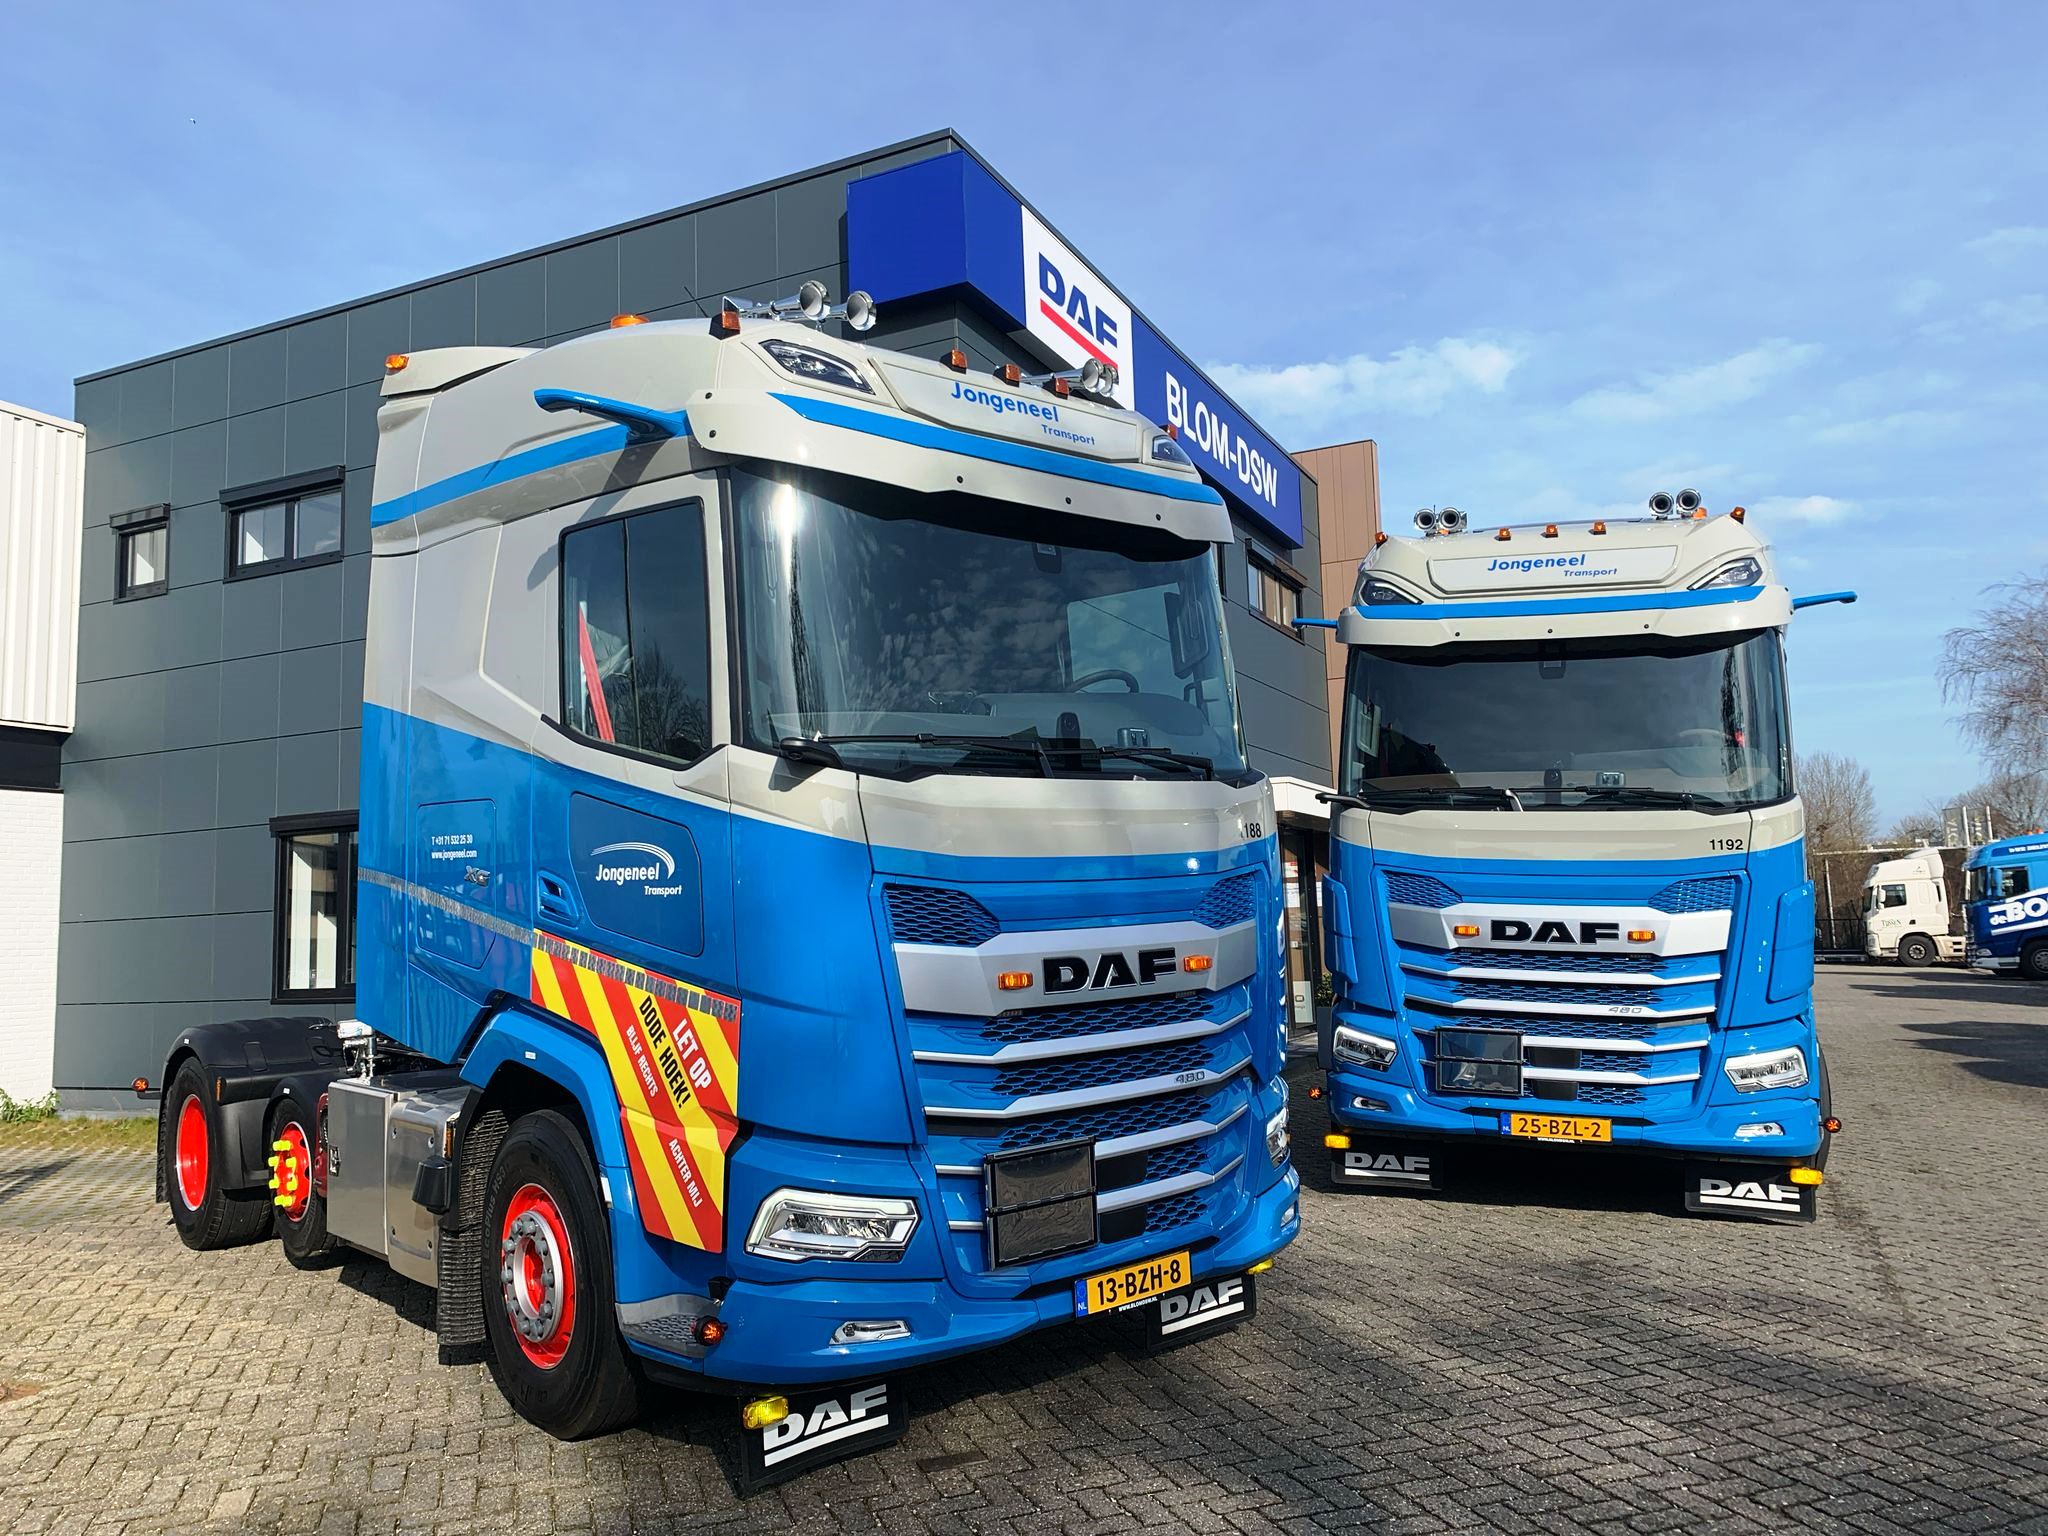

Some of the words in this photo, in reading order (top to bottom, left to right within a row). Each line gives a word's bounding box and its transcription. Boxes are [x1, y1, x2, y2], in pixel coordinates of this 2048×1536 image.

[1039, 251, 1118, 349] DAF
[951, 381, 1059, 422] Jongeneel
[1041, 424, 1096, 446] Transport
[1166, 371, 1278, 508] BLOM-DSW
[1488, 553, 1586, 573] Jongeneel
[1563, 568, 1618, 577] Transport
[444, 835, 450, 845] 71
[1709, 839, 1744, 851] 1192
[595, 862, 660, 886] Jongeneel
[643, 884, 683, 898] Transport
[1490, 919, 1621, 945] DAF
[1043, 946, 1177, 996] DAF
[1608, 1006, 1643, 1015] 480
[626, 1025, 643, 1056] BLIJF
[637, 1054, 659, 1098] RECHTS
[639, 995, 667, 1050] DODE
[659, 1046, 692, 1109] HOEK!
[672, 1018, 698, 1060] LET
[688, 1056, 712, 1090] OP
[1174, 1070, 1205, 1084] 480
[1518, 1117, 1601, 1138] 25-BZL-2
[668, 1139, 692, 1183] ACHTER
[686, 1180, 704, 1208] MIJ
[1345, 1152, 1430, 1171] DAF
[1700, 1178, 1800, 1201] DAF
[1077, 1302, 1087, 1311] NL
[1097, 1259, 1182, 1306] 13-BZH-8
[1159, 1277, 1244, 1323] DAF
[762, 1383, 888, 1451] DAF
